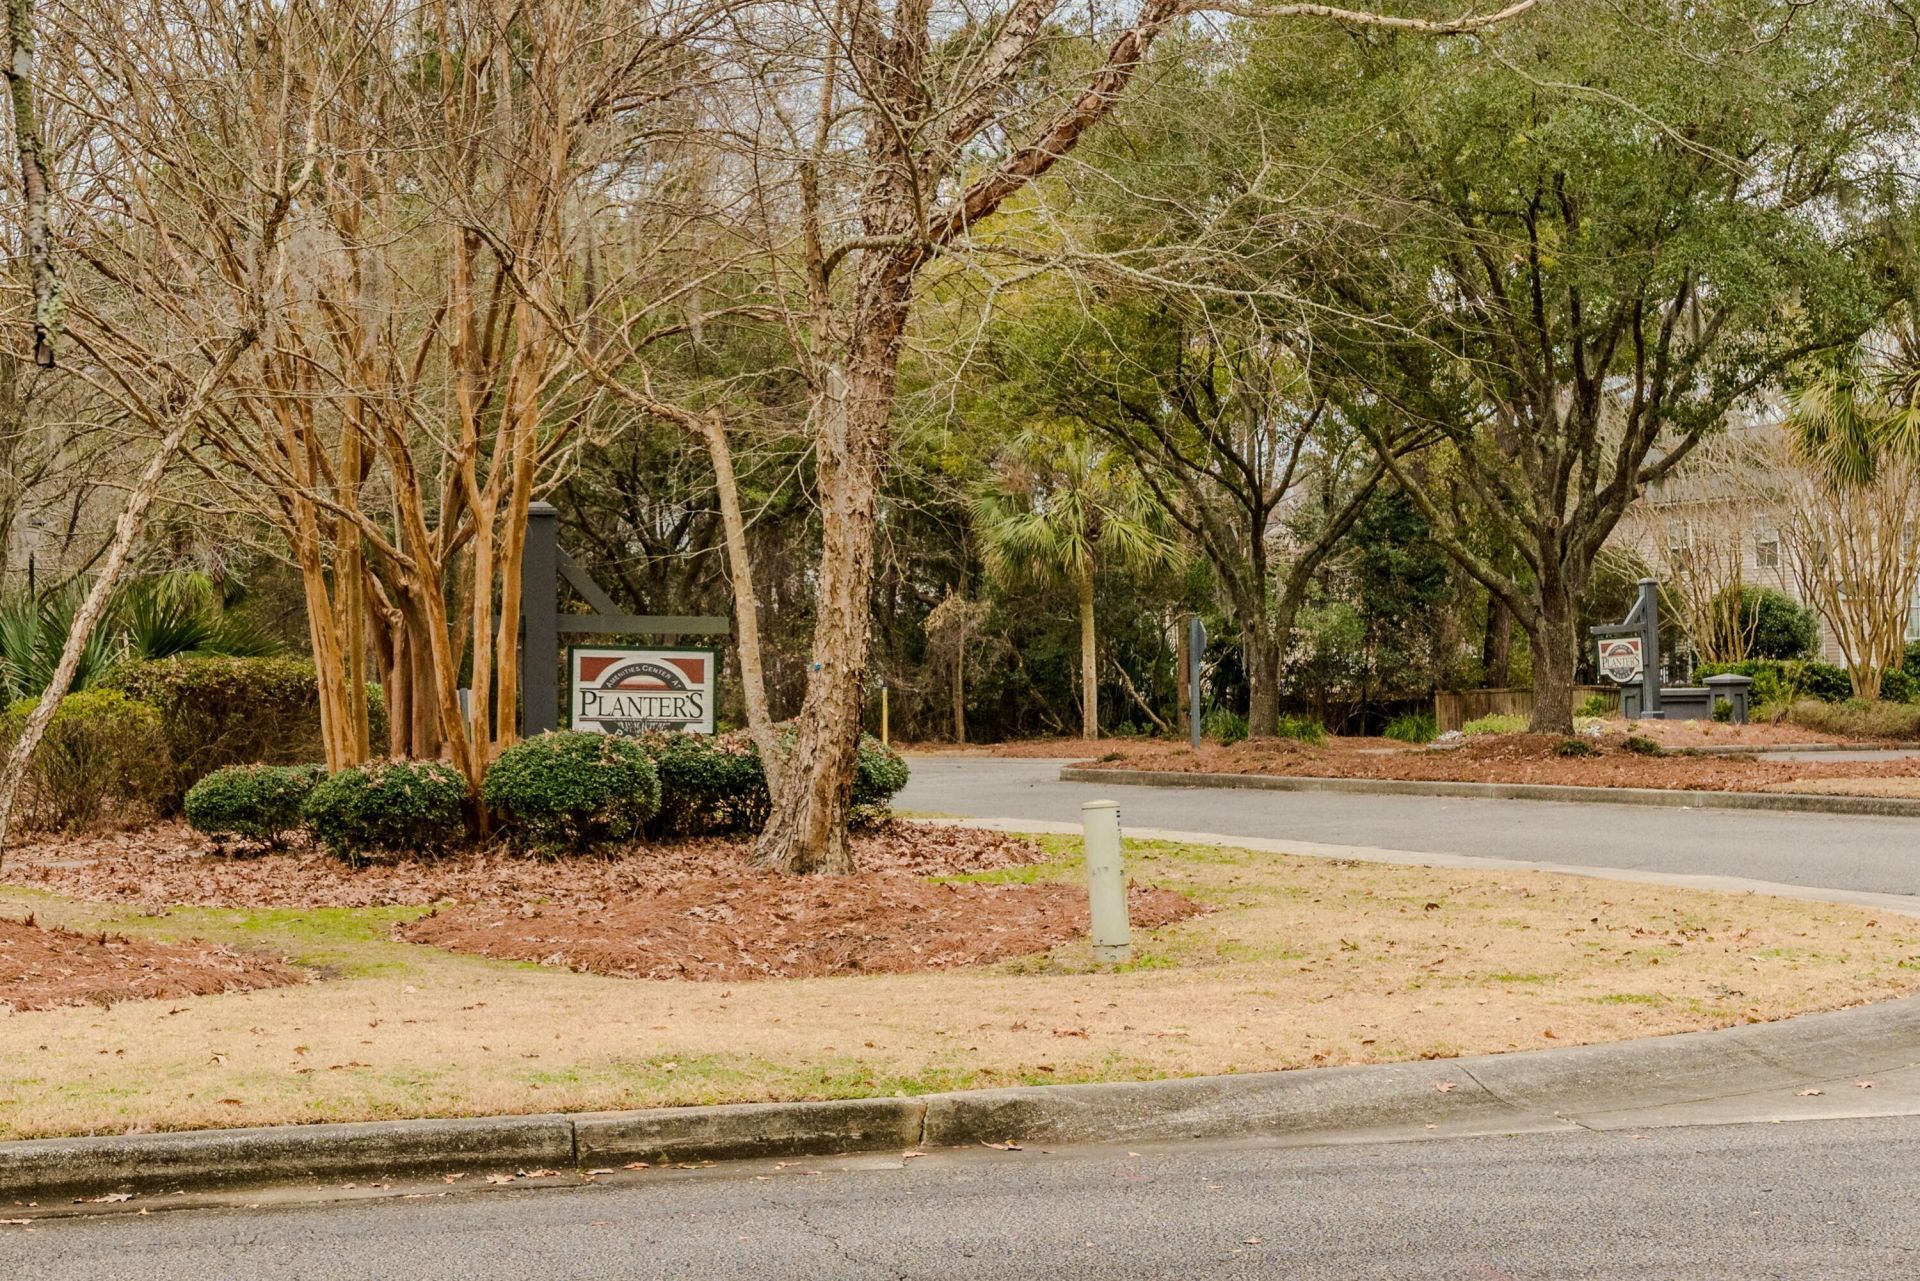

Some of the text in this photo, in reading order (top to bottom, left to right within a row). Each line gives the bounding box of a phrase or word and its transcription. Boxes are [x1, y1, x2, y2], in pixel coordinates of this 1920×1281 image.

[605, 664, 682, 689] AMENITIES CENTER AT
[578, 690, 704, 719] PLANTER'S
